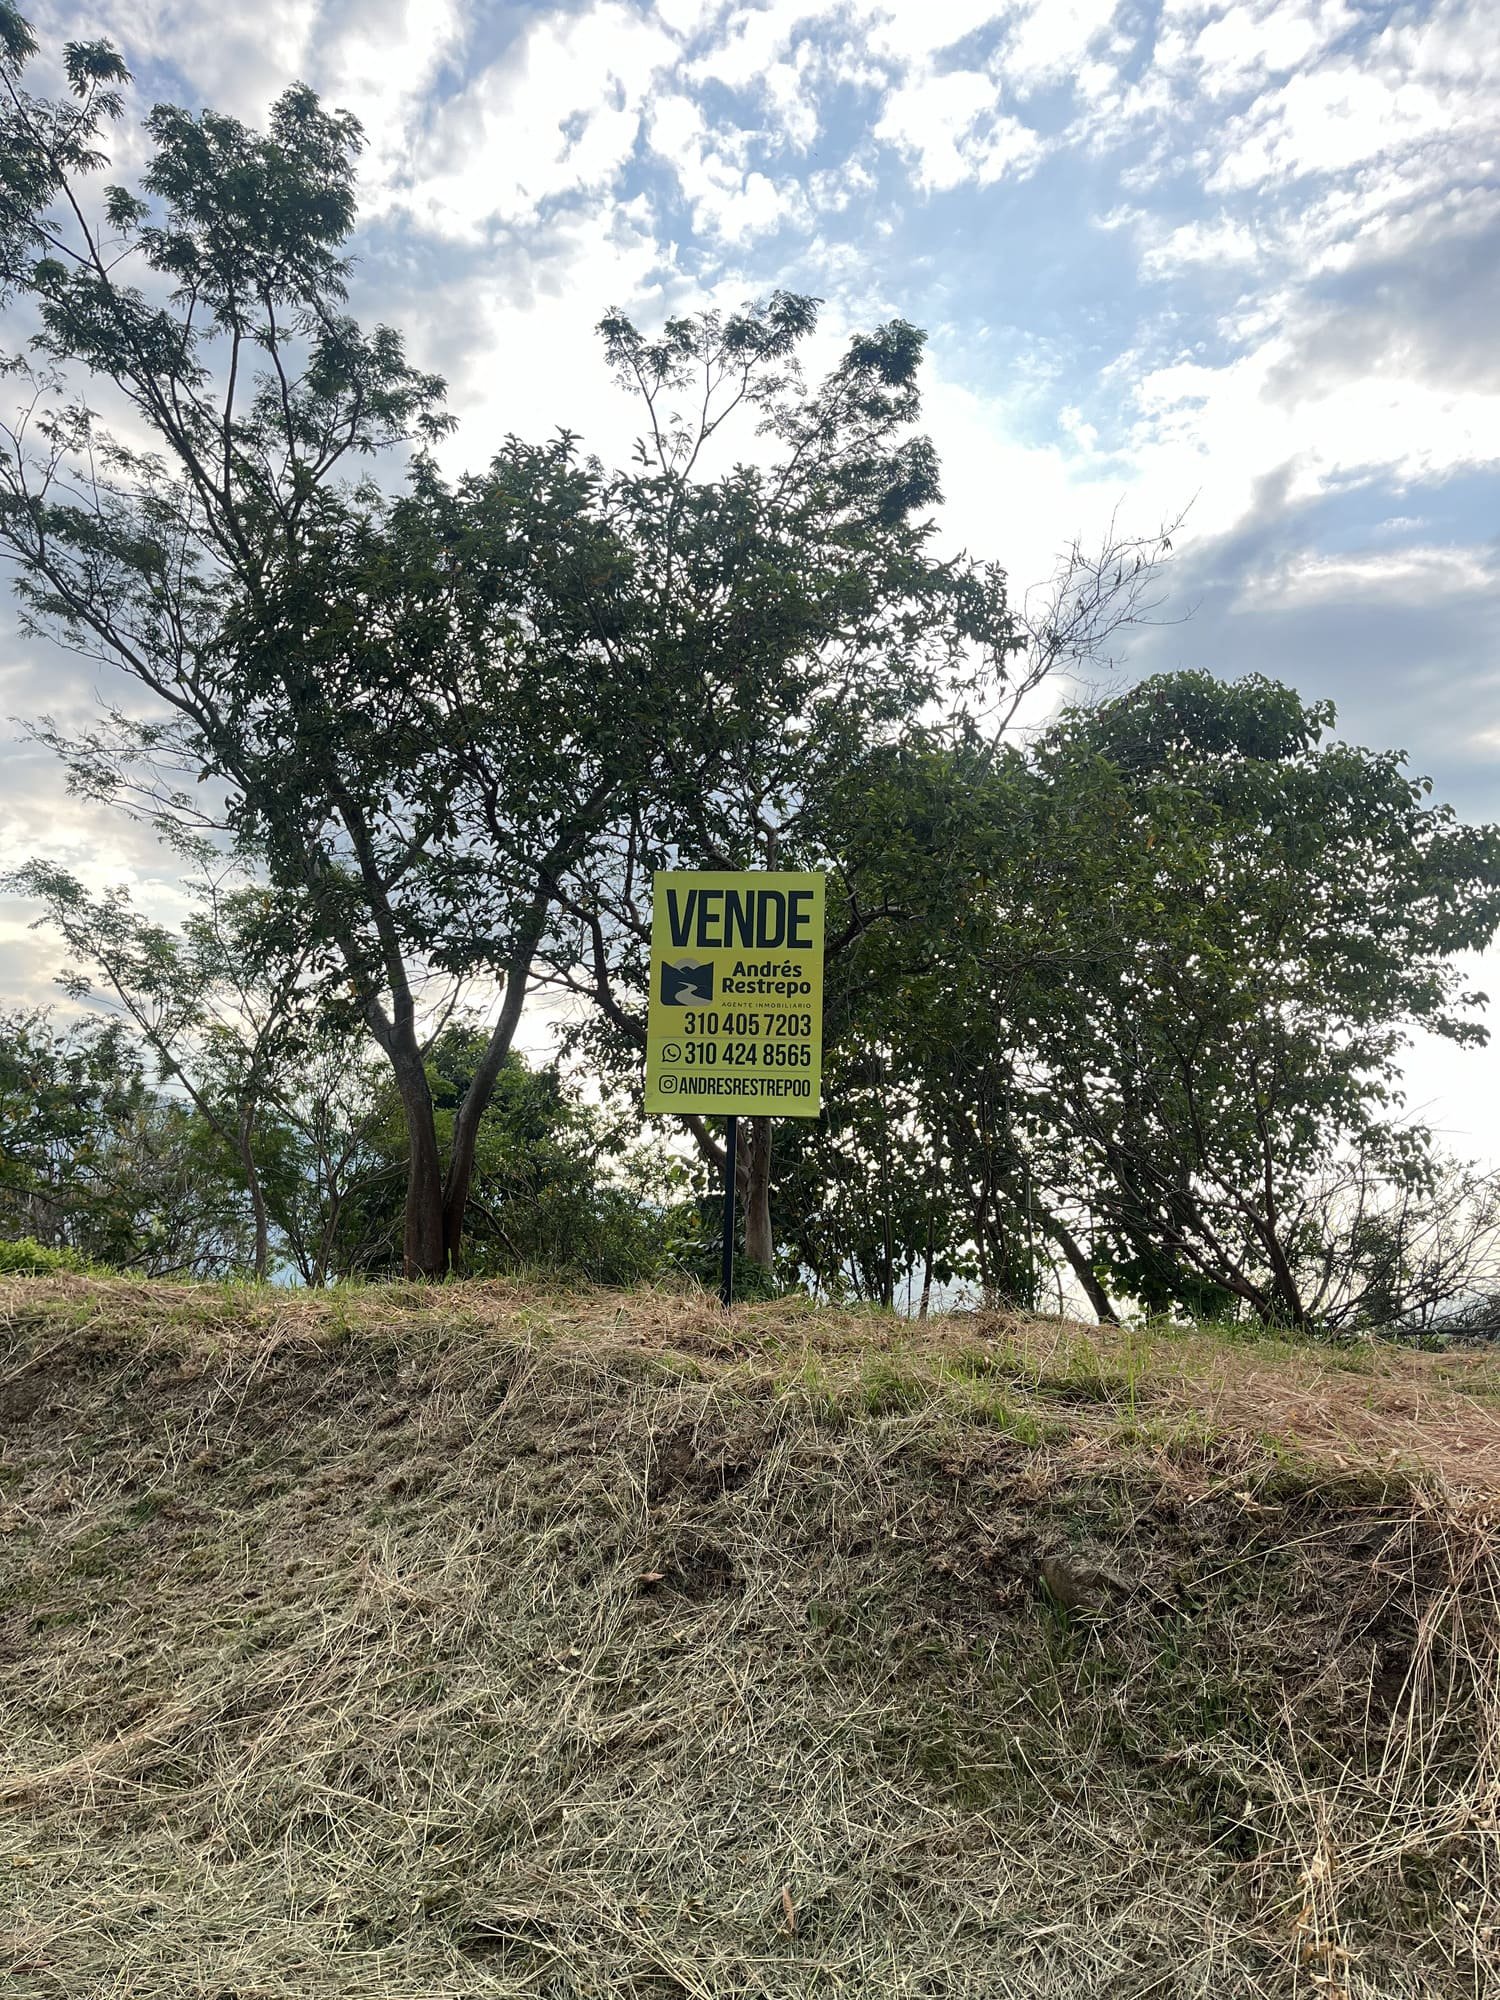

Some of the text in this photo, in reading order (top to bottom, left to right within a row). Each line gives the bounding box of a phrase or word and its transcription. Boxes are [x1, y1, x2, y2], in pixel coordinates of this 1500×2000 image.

[666, 889, 814, 948] VENDE
[732, 960, 802, 977] Andrés
[722, 978, 811, 998] Restrepo
[684, 1012, 812, 1036] 310 405 7203
[684, 1042, 811, 1066] 310 424 8565
[679, 1077, 811, 1097] ANDRESRESTREPOO
